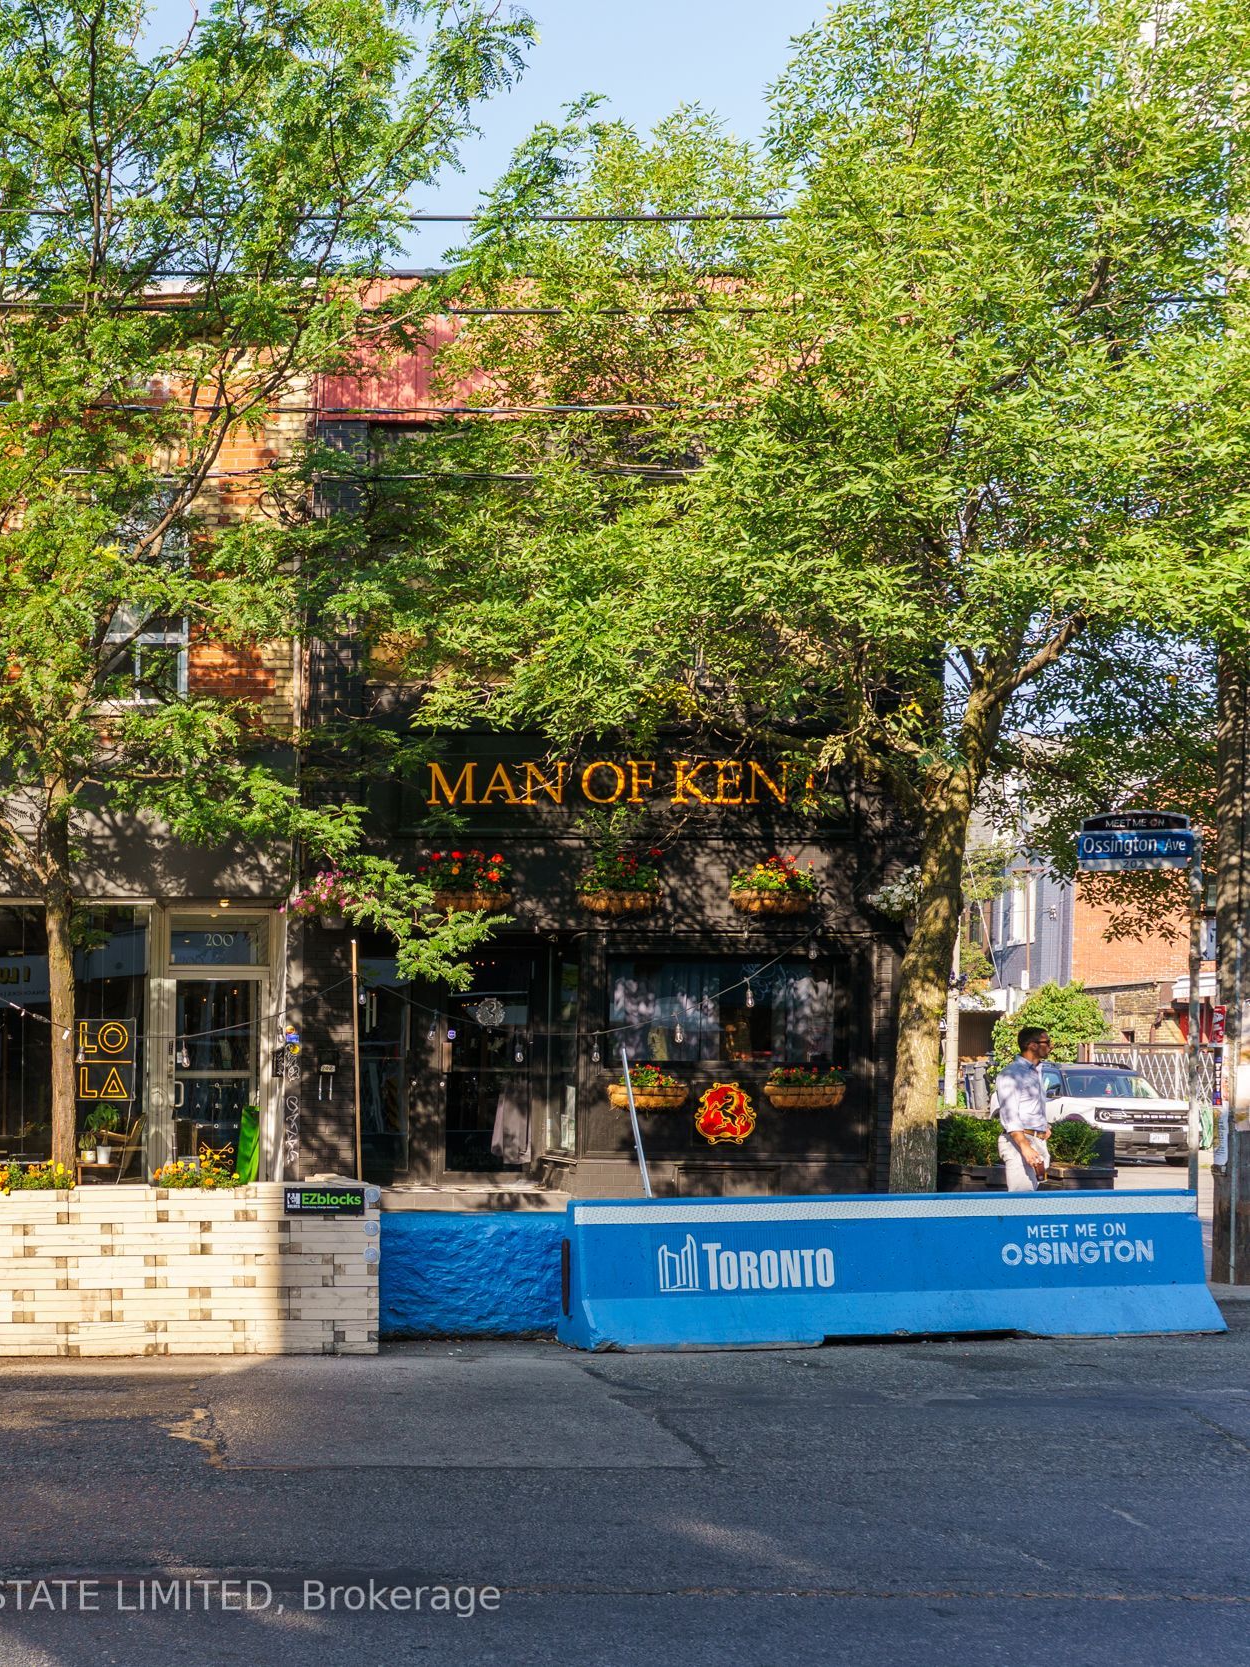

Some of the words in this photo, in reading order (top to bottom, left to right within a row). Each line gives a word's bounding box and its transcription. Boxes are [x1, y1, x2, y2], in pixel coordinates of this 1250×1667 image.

[426, 761, 567, 805] MAN
[582, 761, 656, 805] OF
[1105, 819, 1131, 828] MEET
[1132, 818, 1147, 827] ME
[1149, 818, 1165, 827] ON
[1083, 836, 1158, 856] Ossington
[1164, 838, 1186, 851] Ave
[1123, 860, 1147, 869] 202
[204, 933, 234, 947] 200
[79, 1022, 129, 1054] LO
[79, 1067, 128, 1098] LA
[301, 1192, 362, 1205] EZblocks
[1027, 1224, 1069, 1239] MEET
[1075, 1223, 1098, 1237] ME
[1103, 1222, 1127, 1237] ON
[1001, 1239, 1155, 1266] OSSINGTON
[701, 1242, 835, 1291] TORONTO
